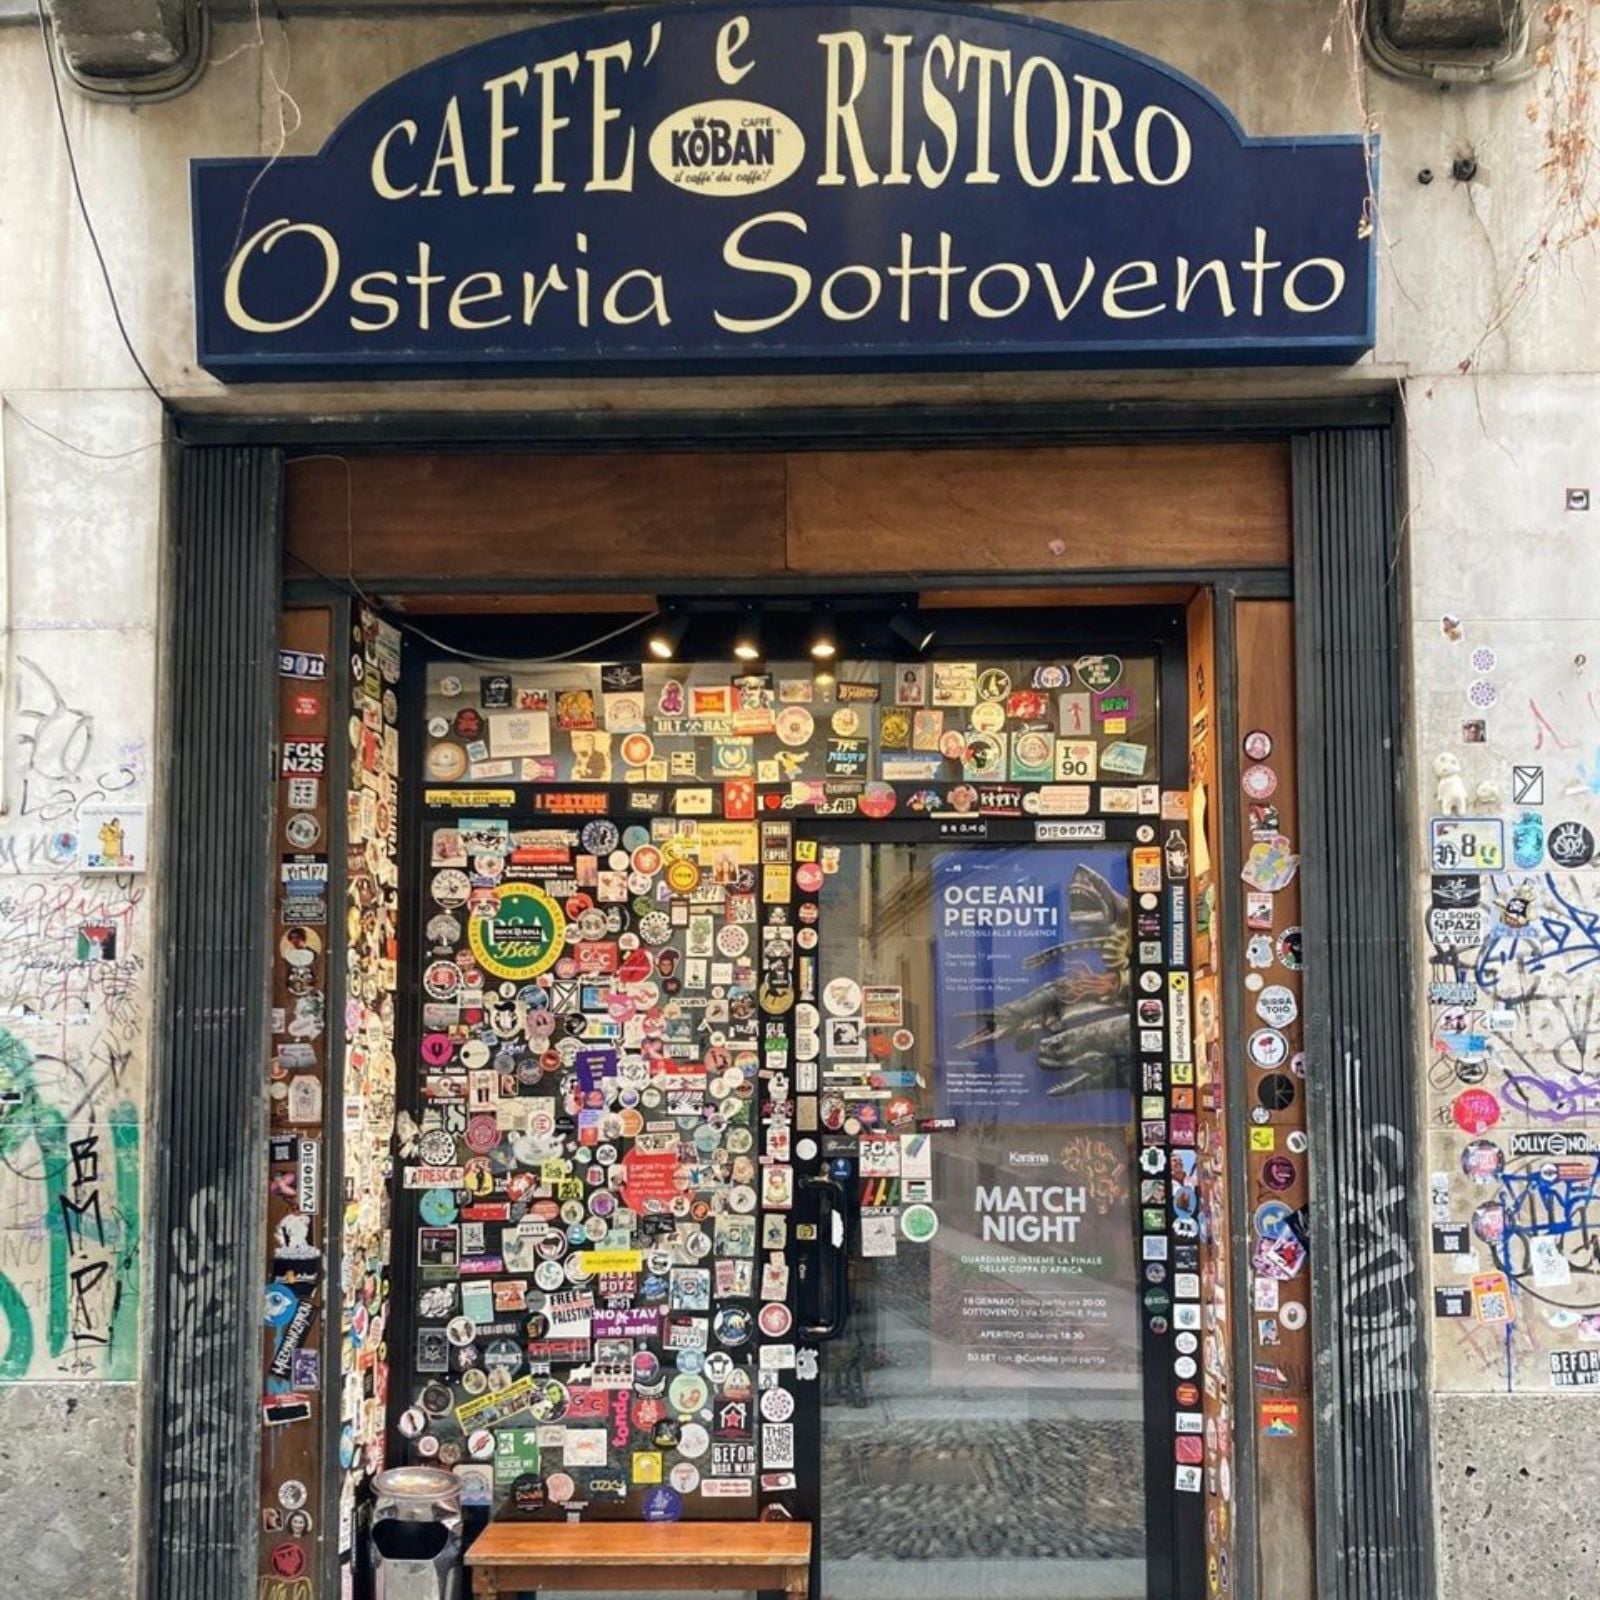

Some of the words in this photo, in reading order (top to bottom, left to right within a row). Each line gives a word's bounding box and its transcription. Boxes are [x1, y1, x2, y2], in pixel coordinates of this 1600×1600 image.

[714, 15, 756, 85] e
[816, 30, 1193, 189] RISTORO
[671, 118, 775, 167] KOBAN
[674, 171, 683, 183] il
[715, 171, 733, 182] dei
[224, 218, 671, 333] Osteria
[713, 211, 1346, 333] Sottovento
[283, 742, 325, 758] FCK
[282, 757, 324, 773] NZS
[1062, 760, 1087, 776] 90
[1461, 833, 1477, 858] 8
[944, 885, 1044, 905] OCEANI
[944, 907, 1058, 926] PERDUTI
[1434, 911, 1447, 919] CI
[1448, 911, 1481, 919] SONO
[1434, 935, 1452, 944] LA
[1454, 935, 1481, 944] VITA
[1175, 989, 1186, 1017] Radio
[1175, 1019, 1186, 1059] Popolare
[975, 1186, 1086, 1212] MATCH
[982, 1216, 1081, 1243] NIGHT
[960, 1255, 1016, 1264] GUARDIAMO
[1018, 1255, 1054, 1264] INSIEME
[1057, 1256, 1069, 1265] LA
[1071, 1256, 1103, 1265] FINALE
[978, 1264, 1007, 1273] DELLA
[1008, 1265, 1039, 1273] COPPA
[974, 1297, 1014, 1306] GENNAIO
[593, 1309, 613, 1319] NO
[632, 1308, 657, 1319] TAV
[962, 1307, 1019, 1317] SOTTOVENTO
[607, 1325, 626, 1335] no
[627, 1324, 658, 1335] mafia
[612, 1389, 630, 1448] tondo
[765, 1426, 792, 1437] THIS
[765, 1452, 792, 1462] SONG
